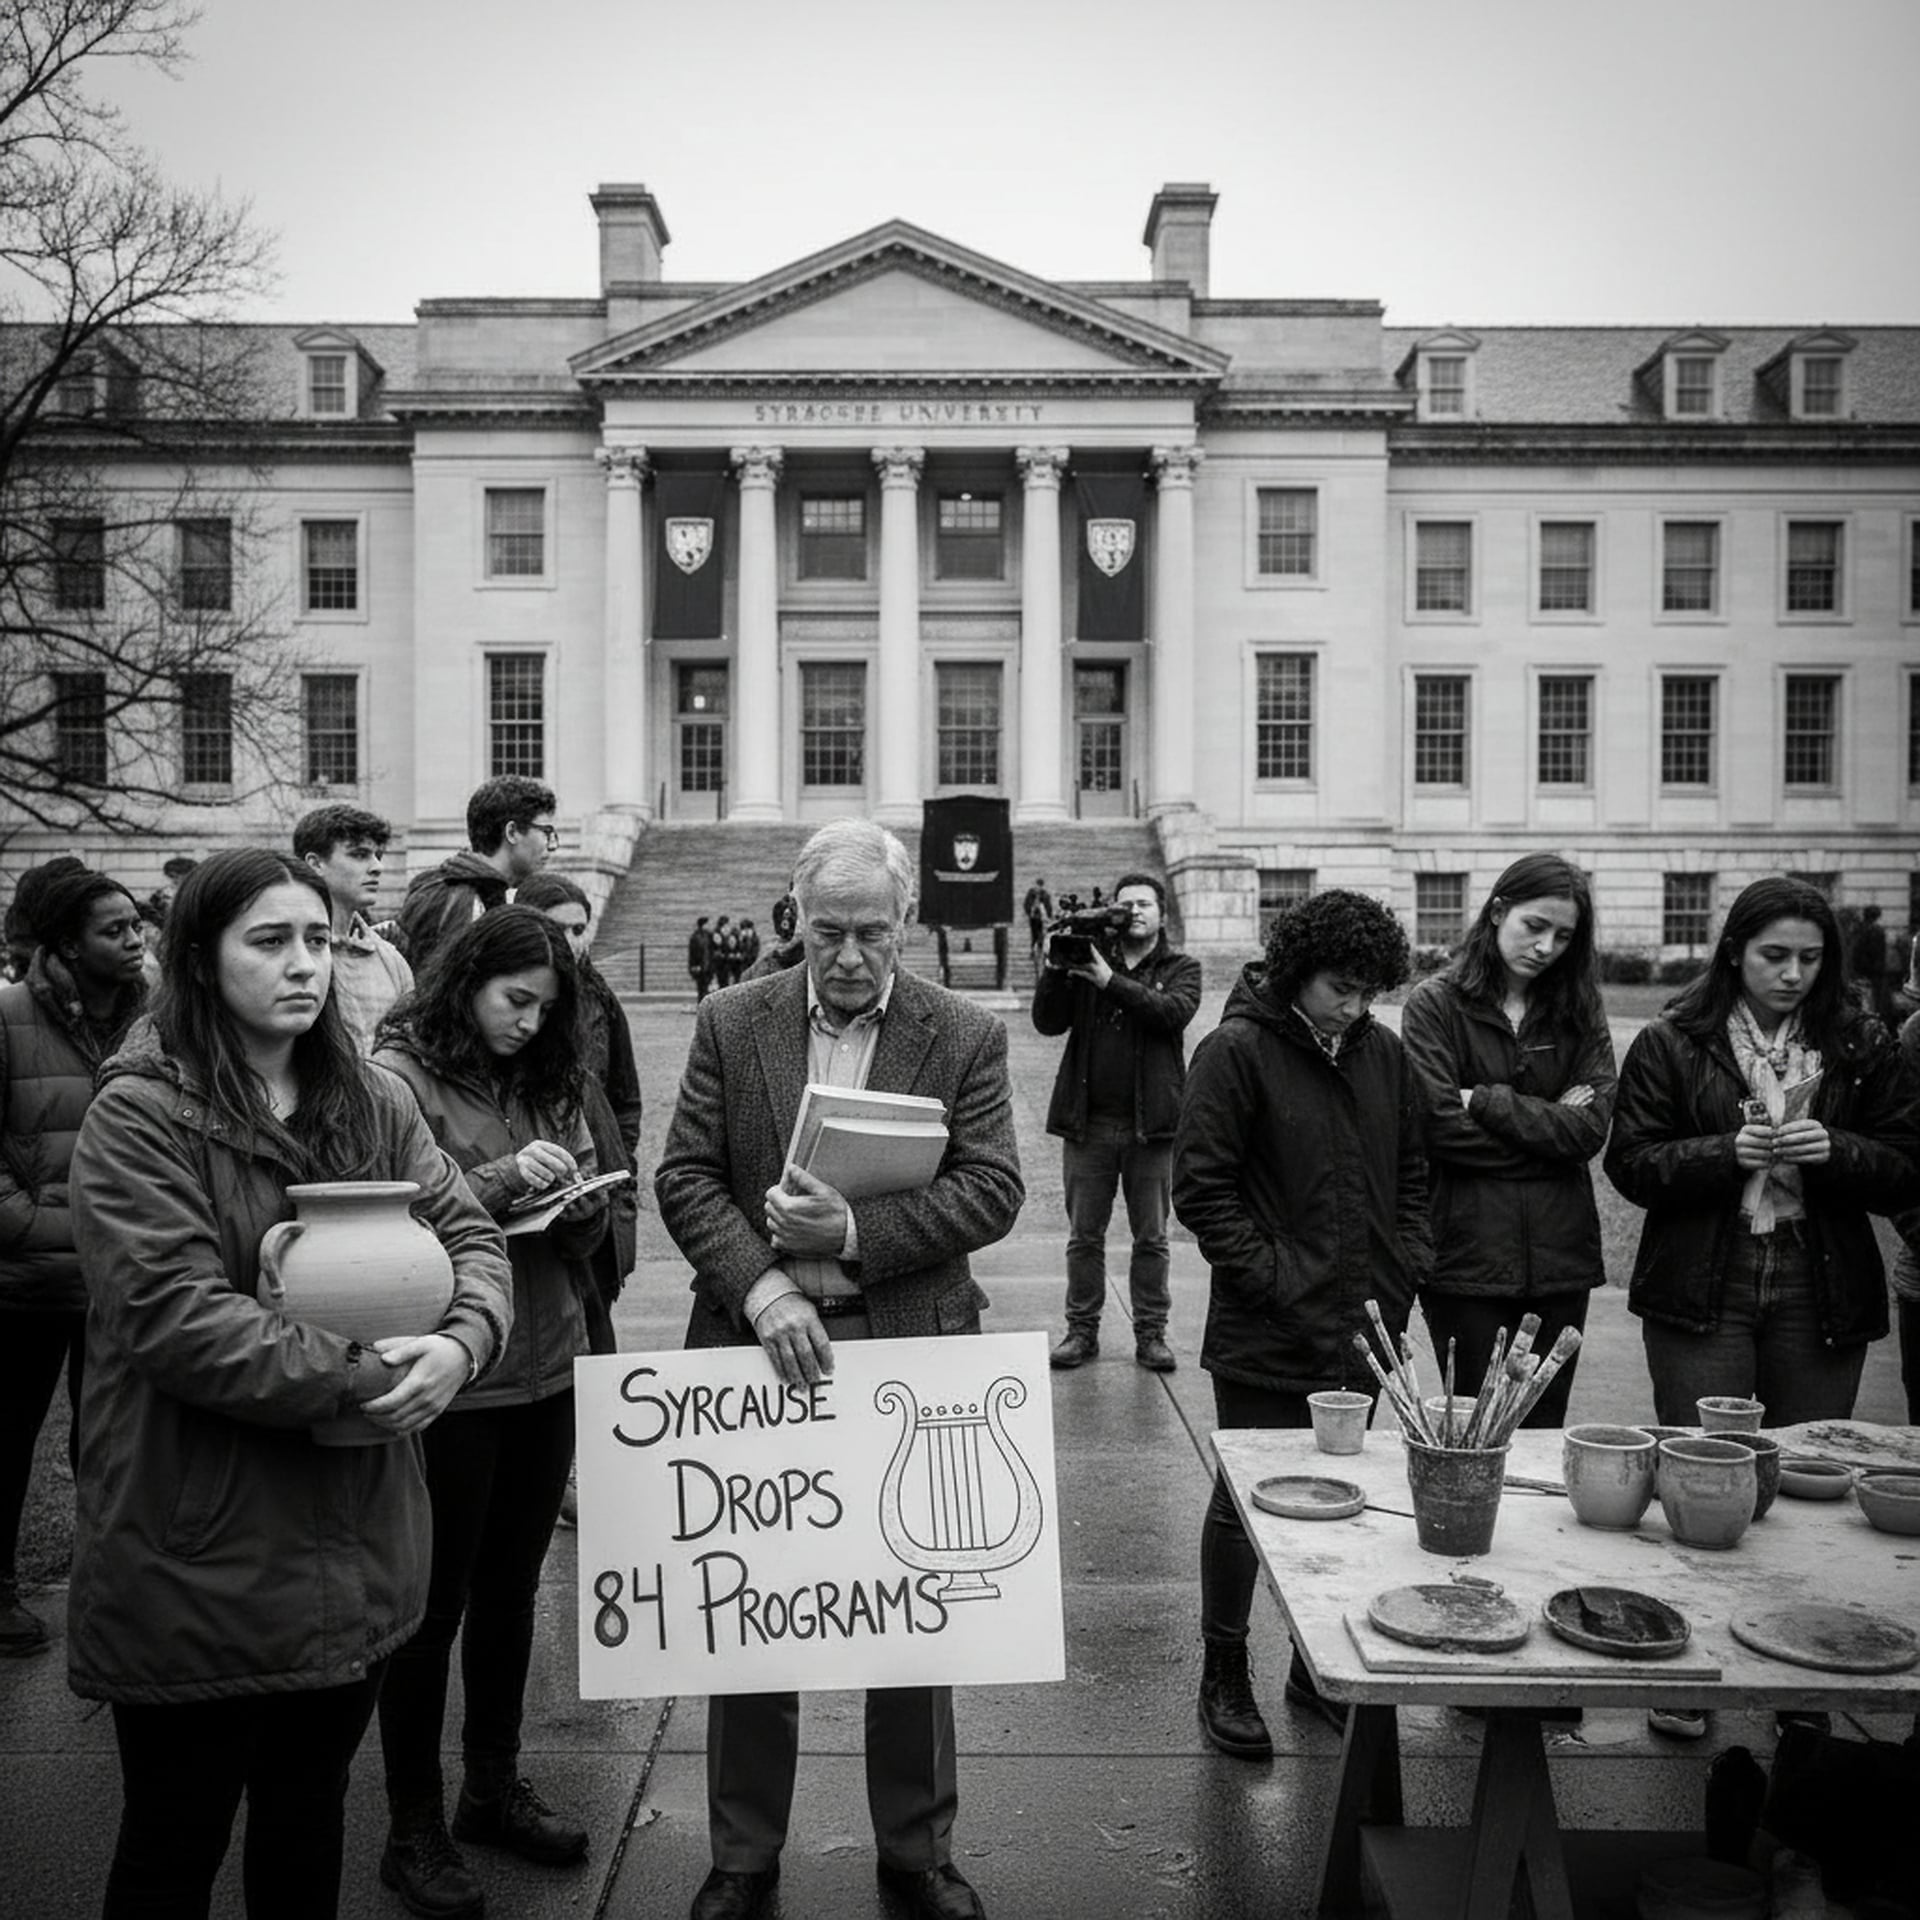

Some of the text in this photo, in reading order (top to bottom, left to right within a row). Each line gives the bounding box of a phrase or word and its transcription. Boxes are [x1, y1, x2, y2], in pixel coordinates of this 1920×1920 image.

[612, 1366, 837, 1448] SYRCAUSE
[667, 1458, 843, 1542] DROPS
[593, 1550, 950, 1655] 84 PROGRAMS
